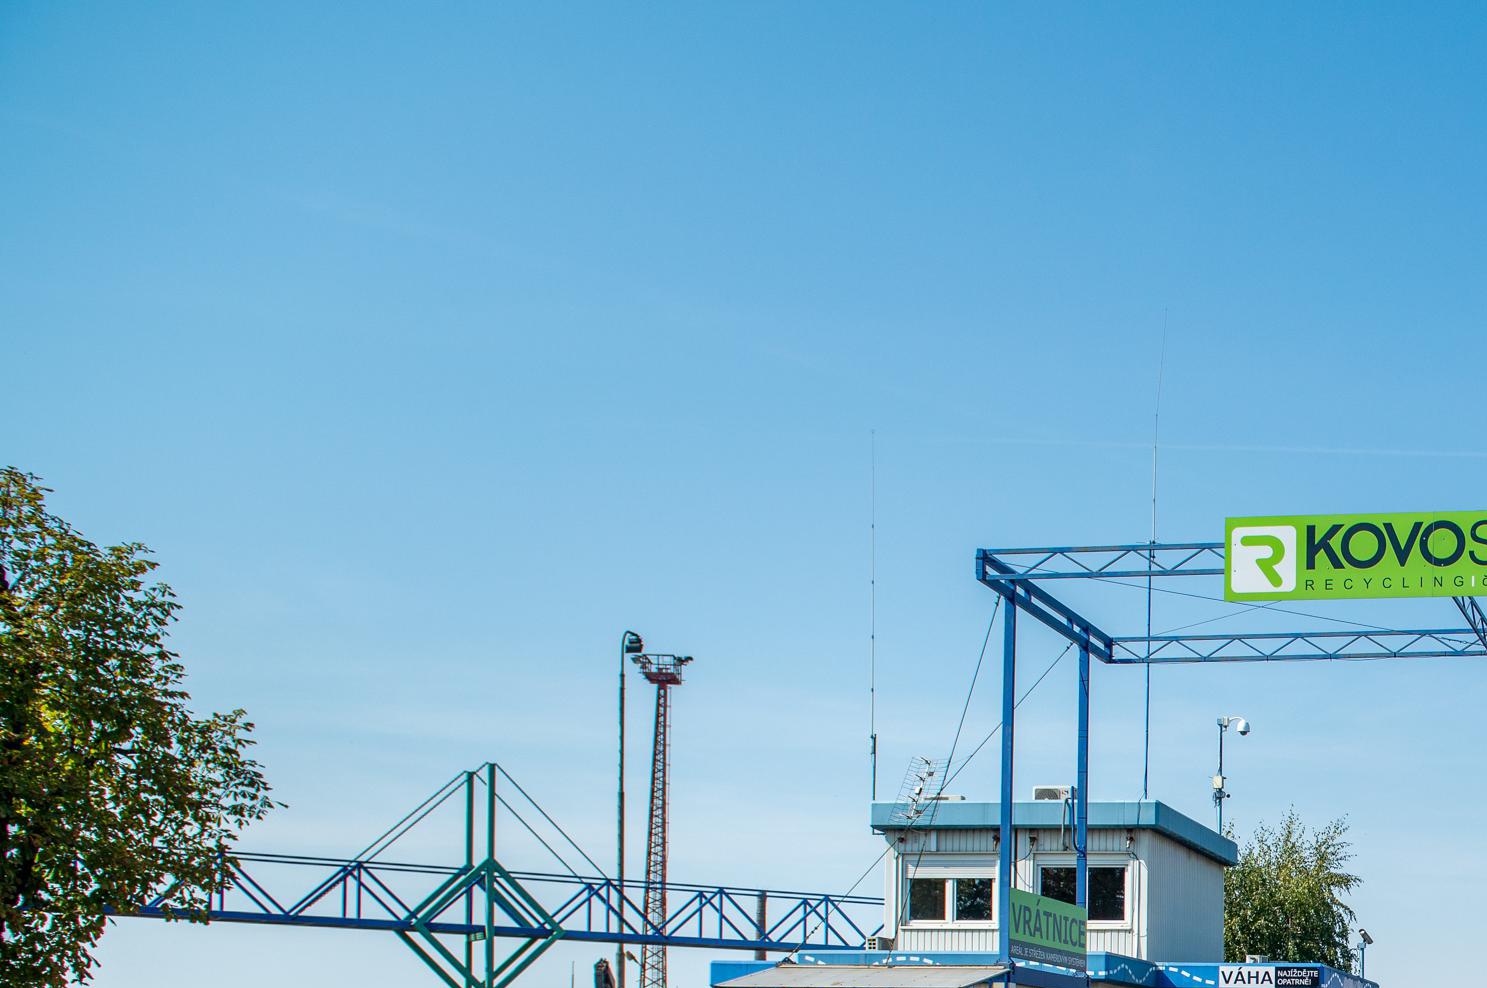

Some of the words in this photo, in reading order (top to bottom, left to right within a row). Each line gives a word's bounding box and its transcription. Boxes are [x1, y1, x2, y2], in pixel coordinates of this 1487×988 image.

[1305, 574, 1465, 591] RECYCLING
[1011, 898, 1087, 949] VRÁTNICE
[1221, 967, 1273, 985] VÁHA
[1277, 970, 1318, 979] NAJÍŽDĚJTE
[1277, 977, 1312, 986] OPATRNĚ!
